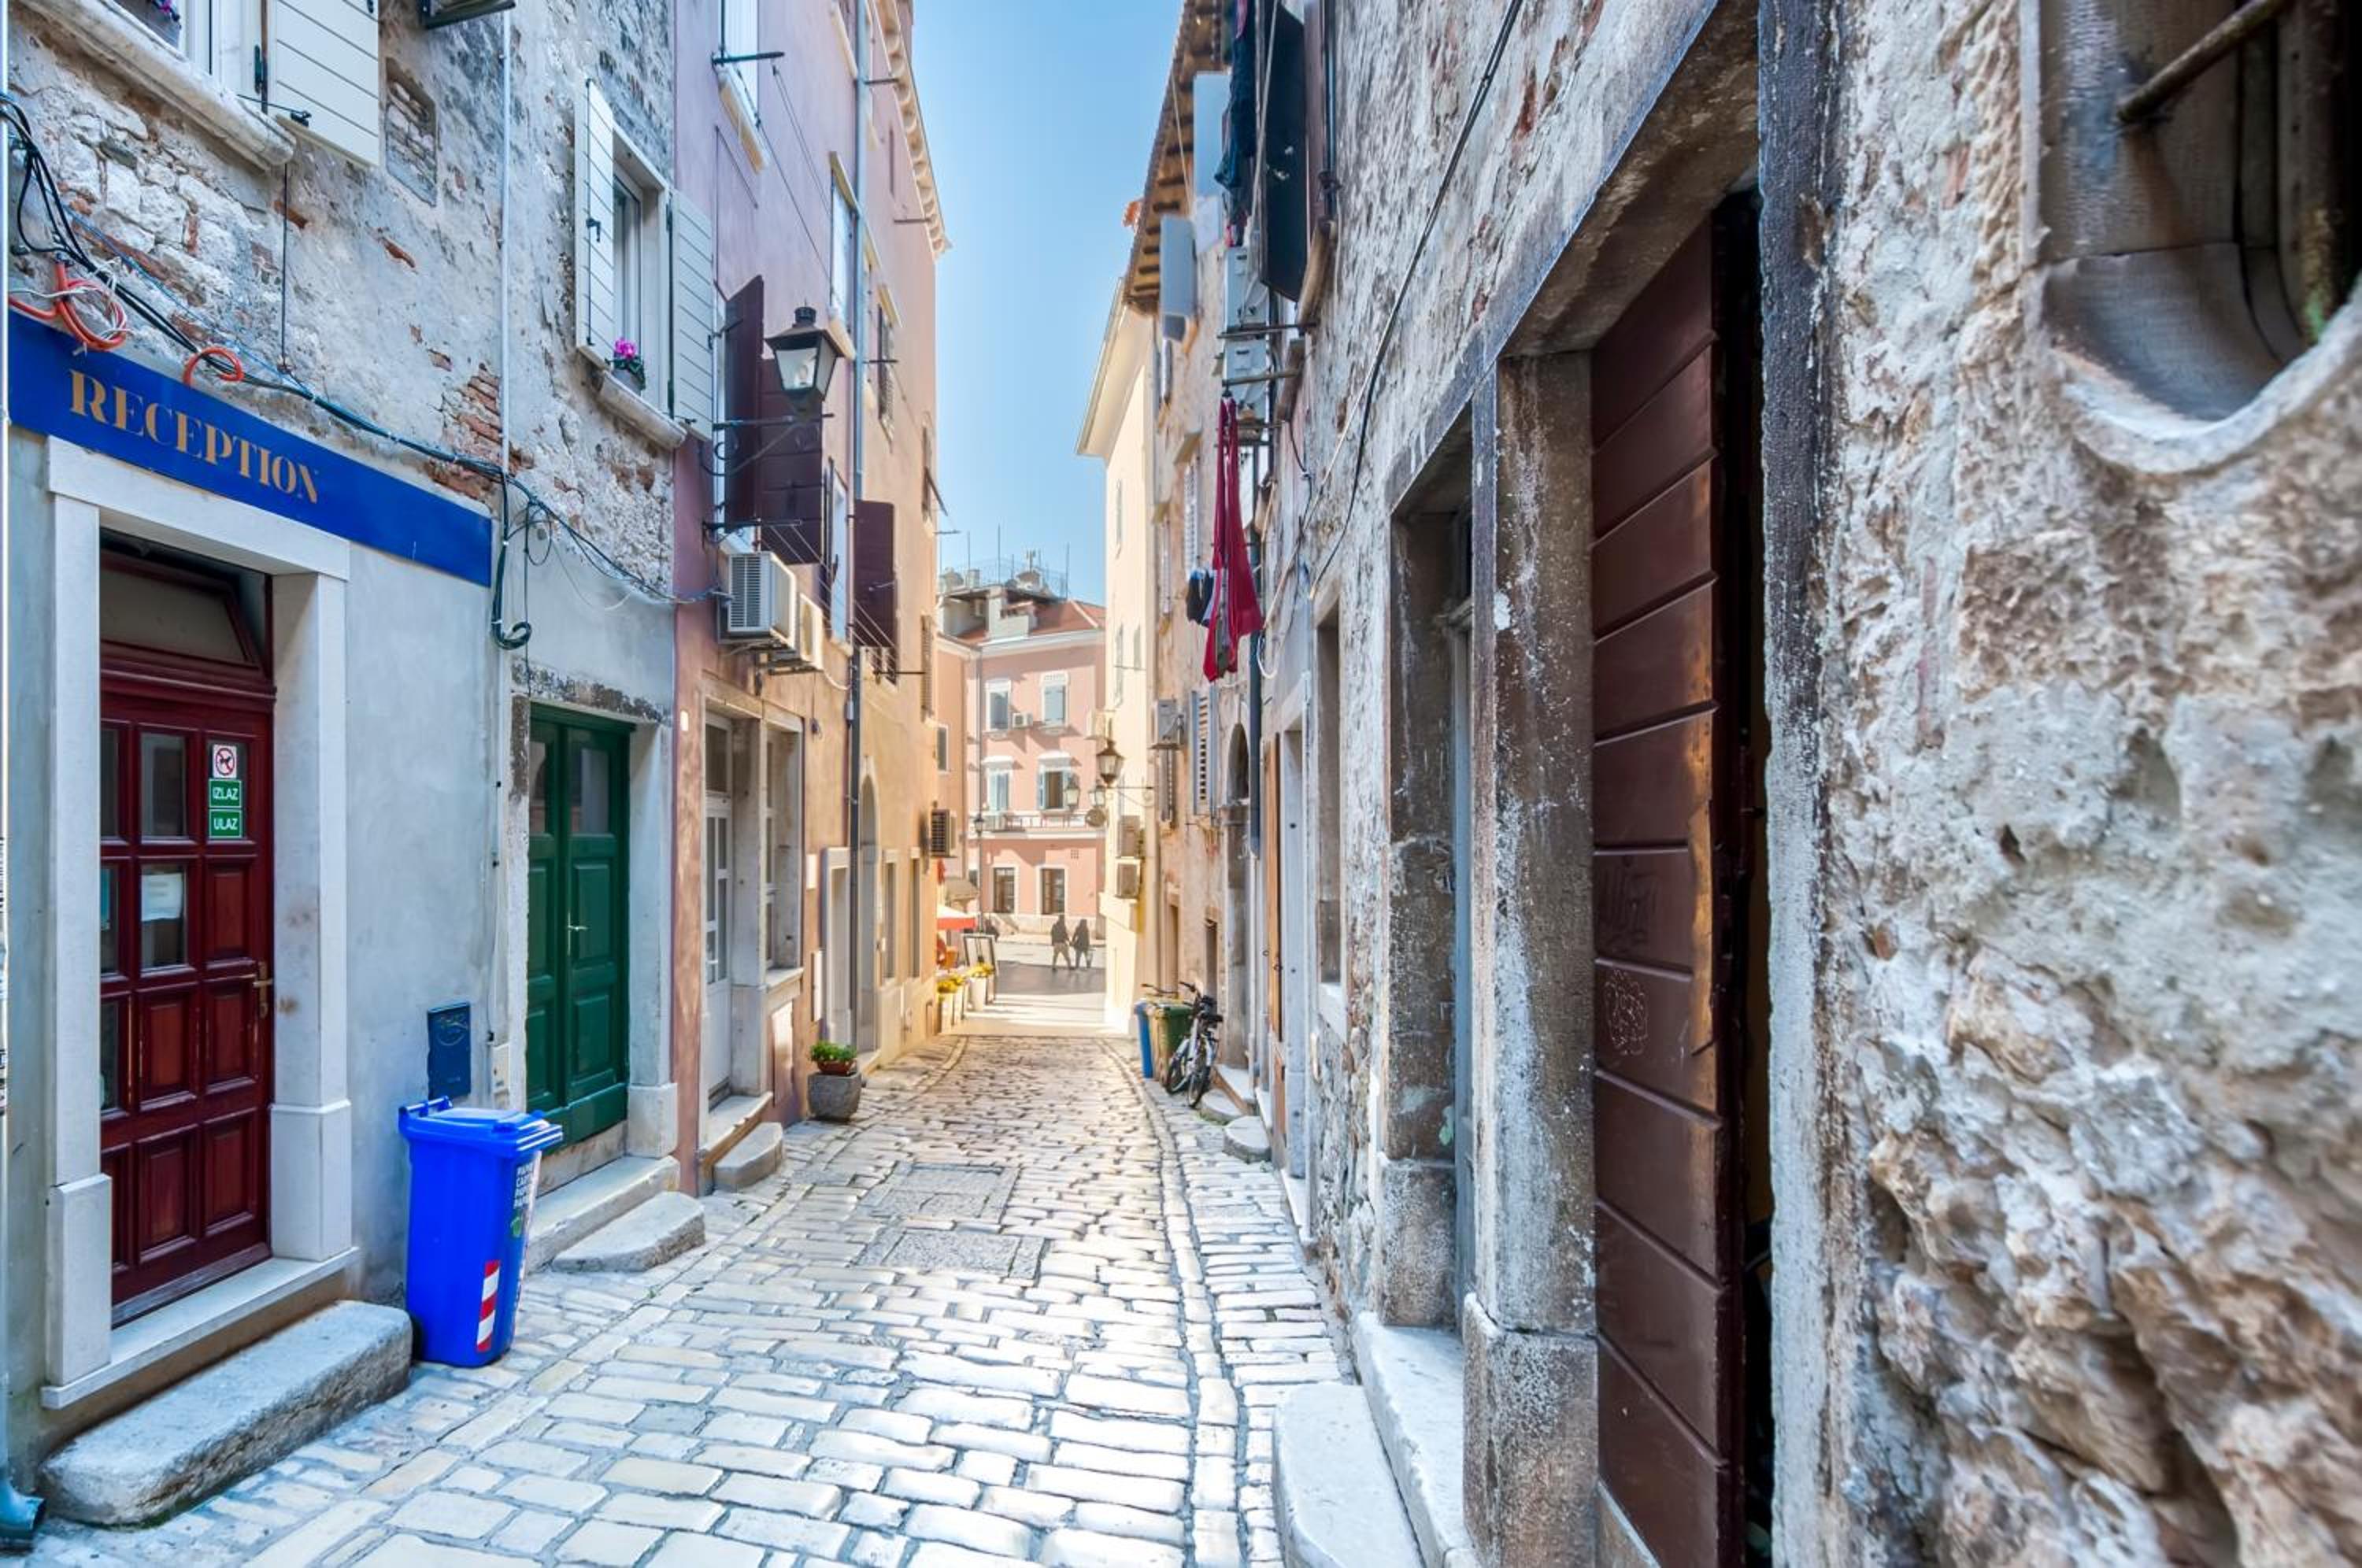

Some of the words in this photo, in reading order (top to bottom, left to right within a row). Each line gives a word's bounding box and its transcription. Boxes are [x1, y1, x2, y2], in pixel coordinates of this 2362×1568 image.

[69, 369, 319, 504] RECEPTION
[213, 786, 239, 801] IZLAZ
[213, 818, 239, 830] ULAZ
